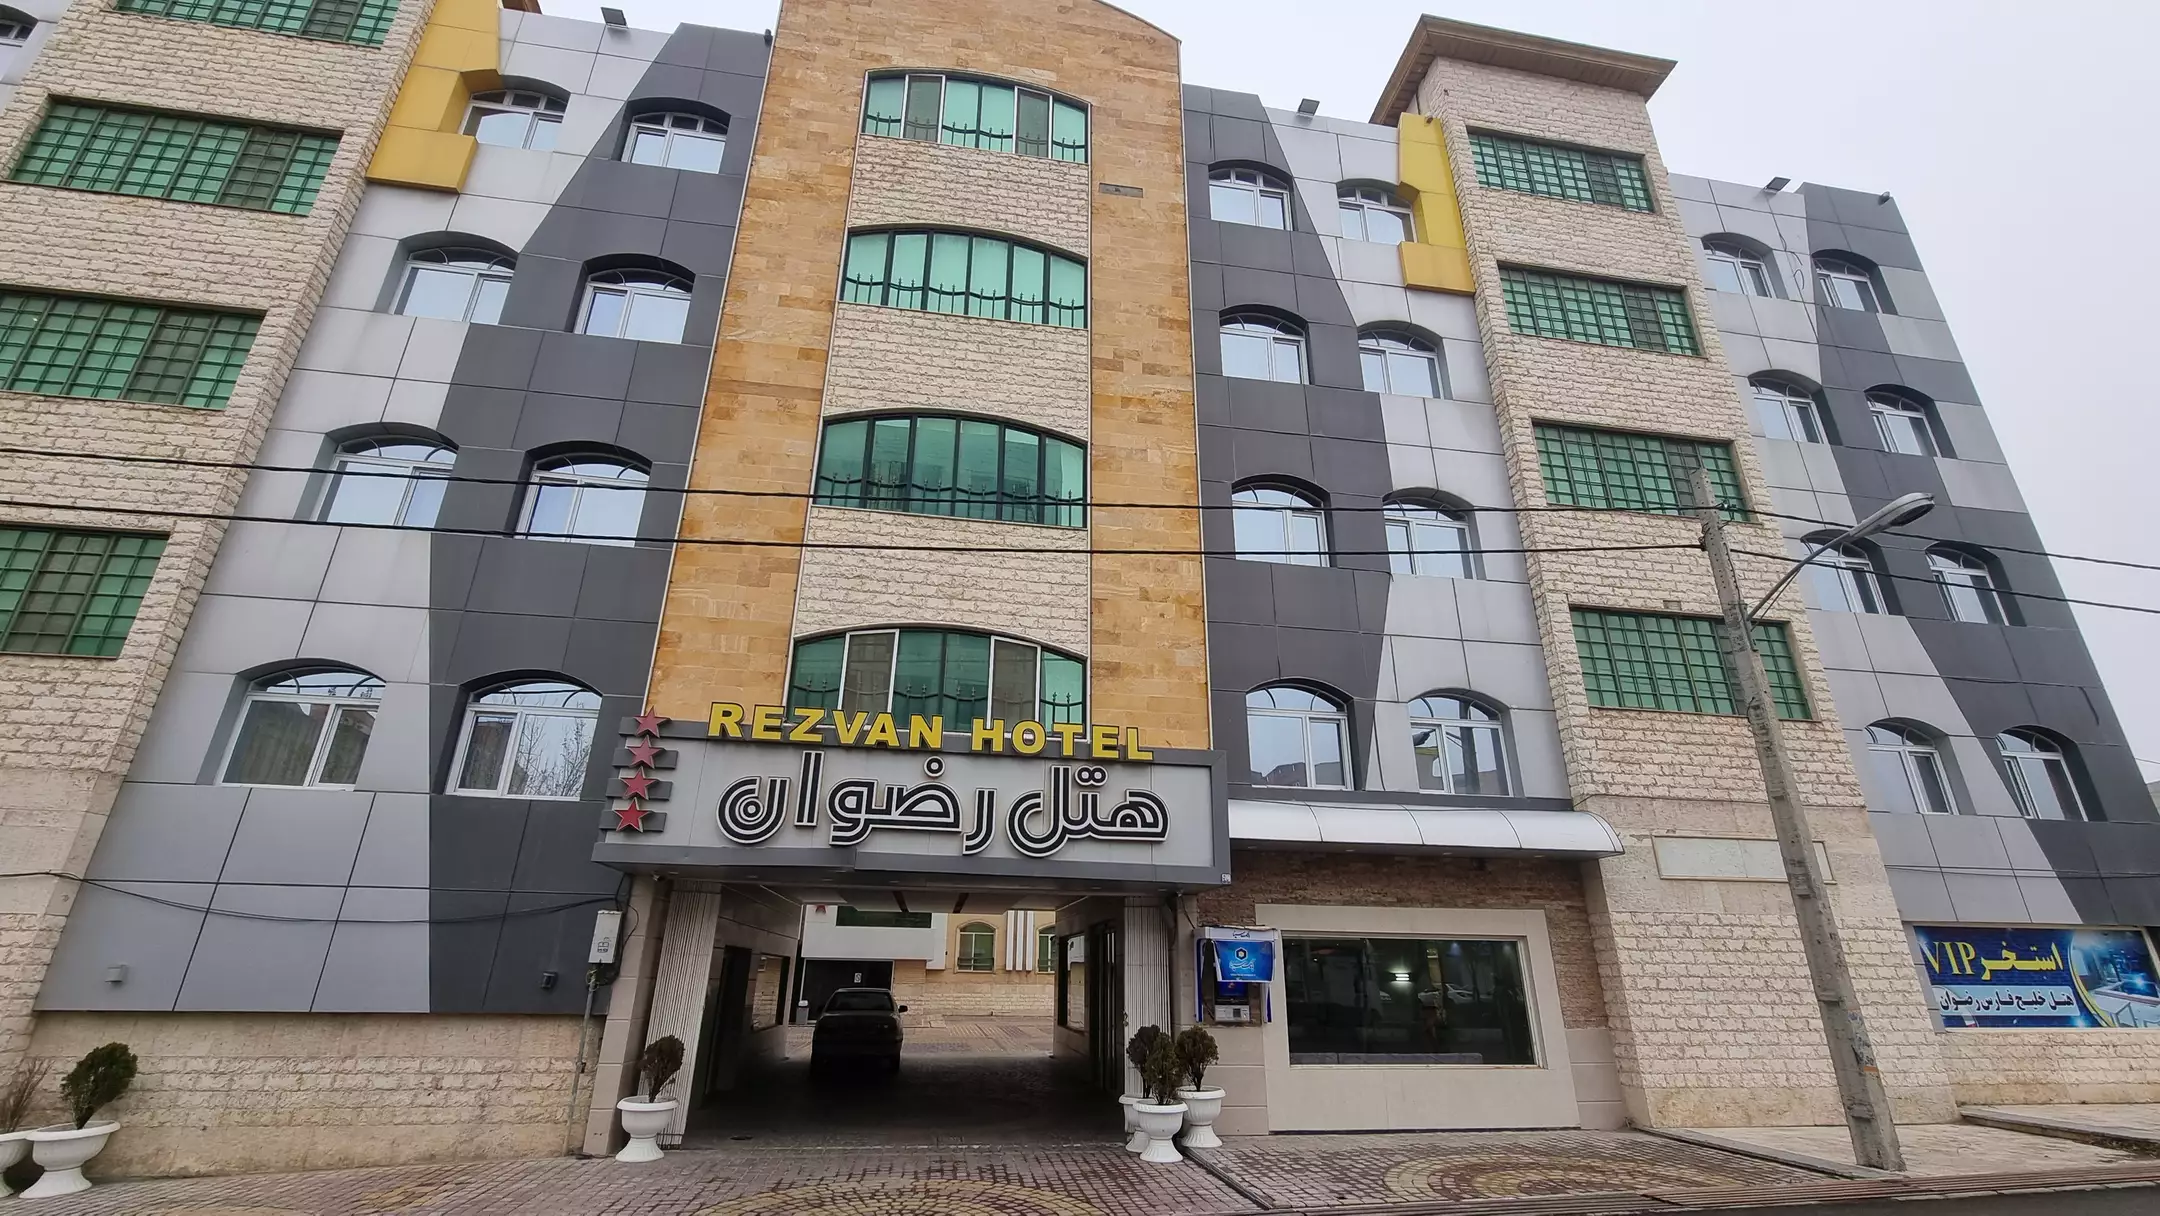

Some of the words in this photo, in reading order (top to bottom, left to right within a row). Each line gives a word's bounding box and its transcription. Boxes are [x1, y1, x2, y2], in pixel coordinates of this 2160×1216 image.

[707, 702, 943, 750] REZVAN
[971, 716, 1154, 761] HOTEL
[715, 750, 998, 856] رضوان
[1005, 764, 1172, 858] هتل
[1918, 941, 1977, 975] VIP
[1981, 941, 2064, 981] استخر
[1939, 990, 1981, 1012] رضوان
[1980, 990, 2015, 1012] فارس
[2015, 991, 2047, 1011] خلیج
[2048, 990, 2075, 1011] هتل
